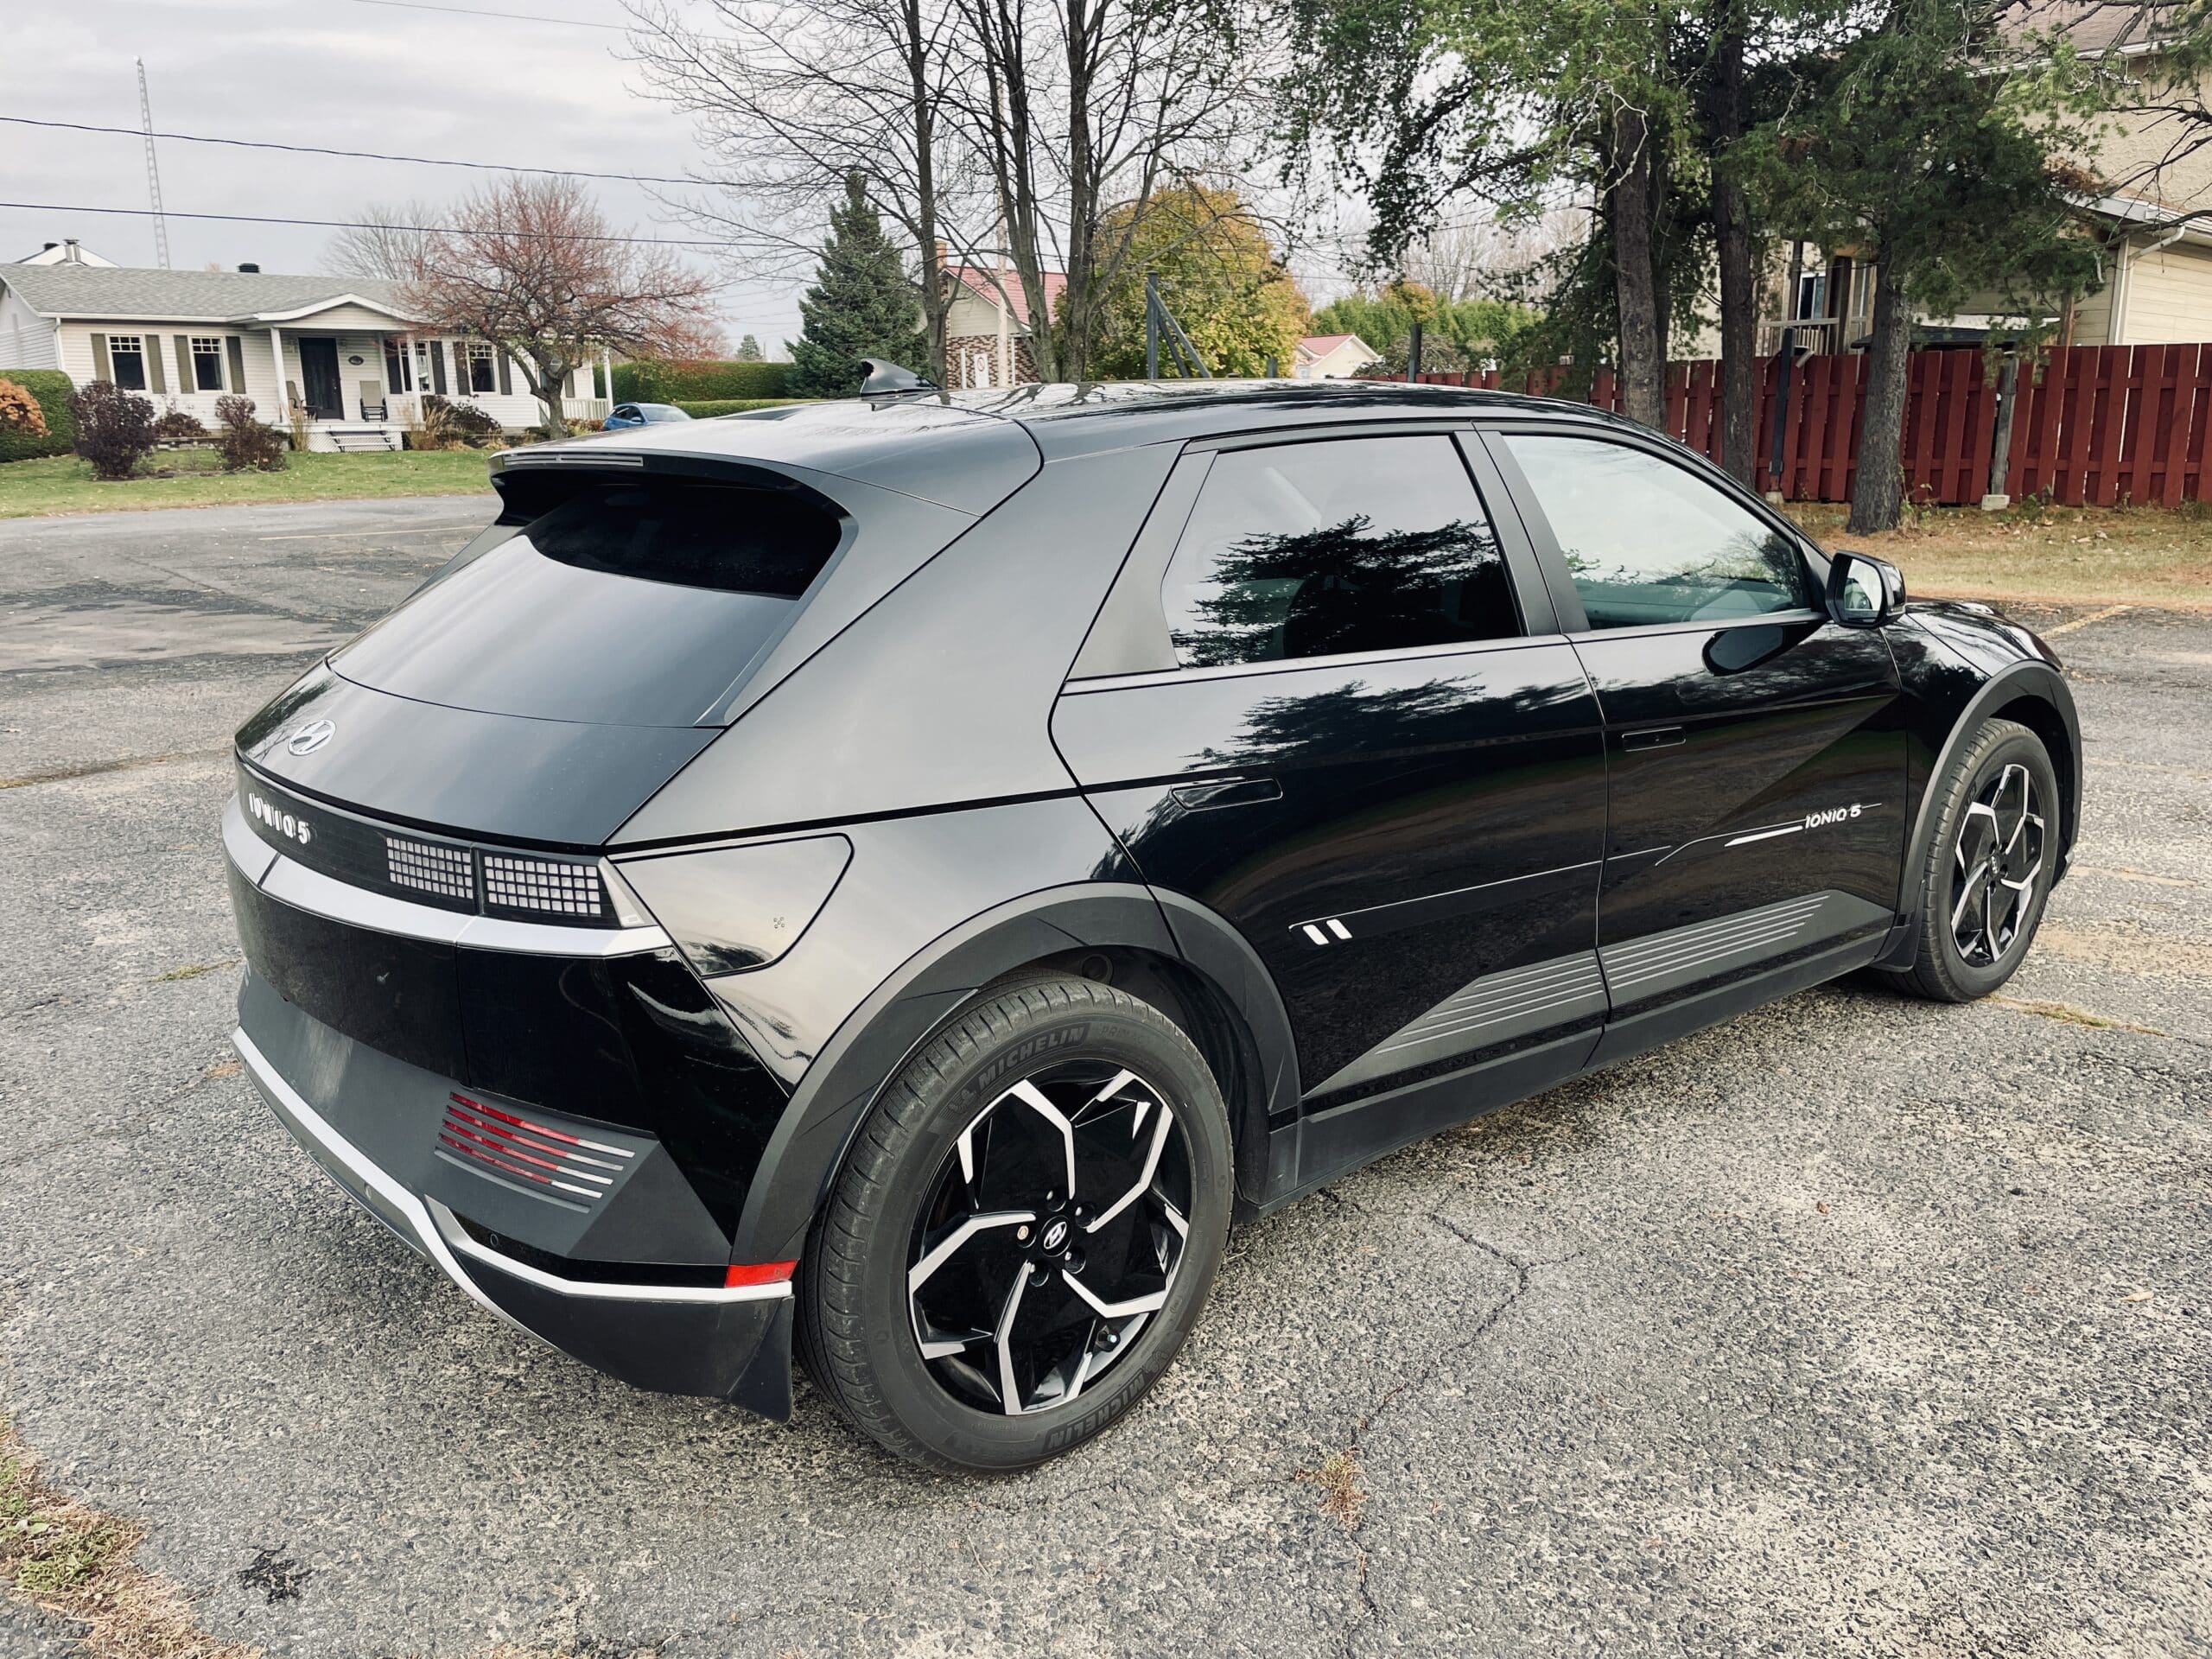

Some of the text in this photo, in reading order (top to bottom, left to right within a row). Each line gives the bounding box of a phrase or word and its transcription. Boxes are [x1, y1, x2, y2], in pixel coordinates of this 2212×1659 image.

[249, 792, 311, 844] IONIQ 5
[1805, 804, 1862, 830] IONIQ 5
[978, 1027, 1085, 1090] MICHELIN
[1049, 1373, 1145, 1449] MICHELIN
